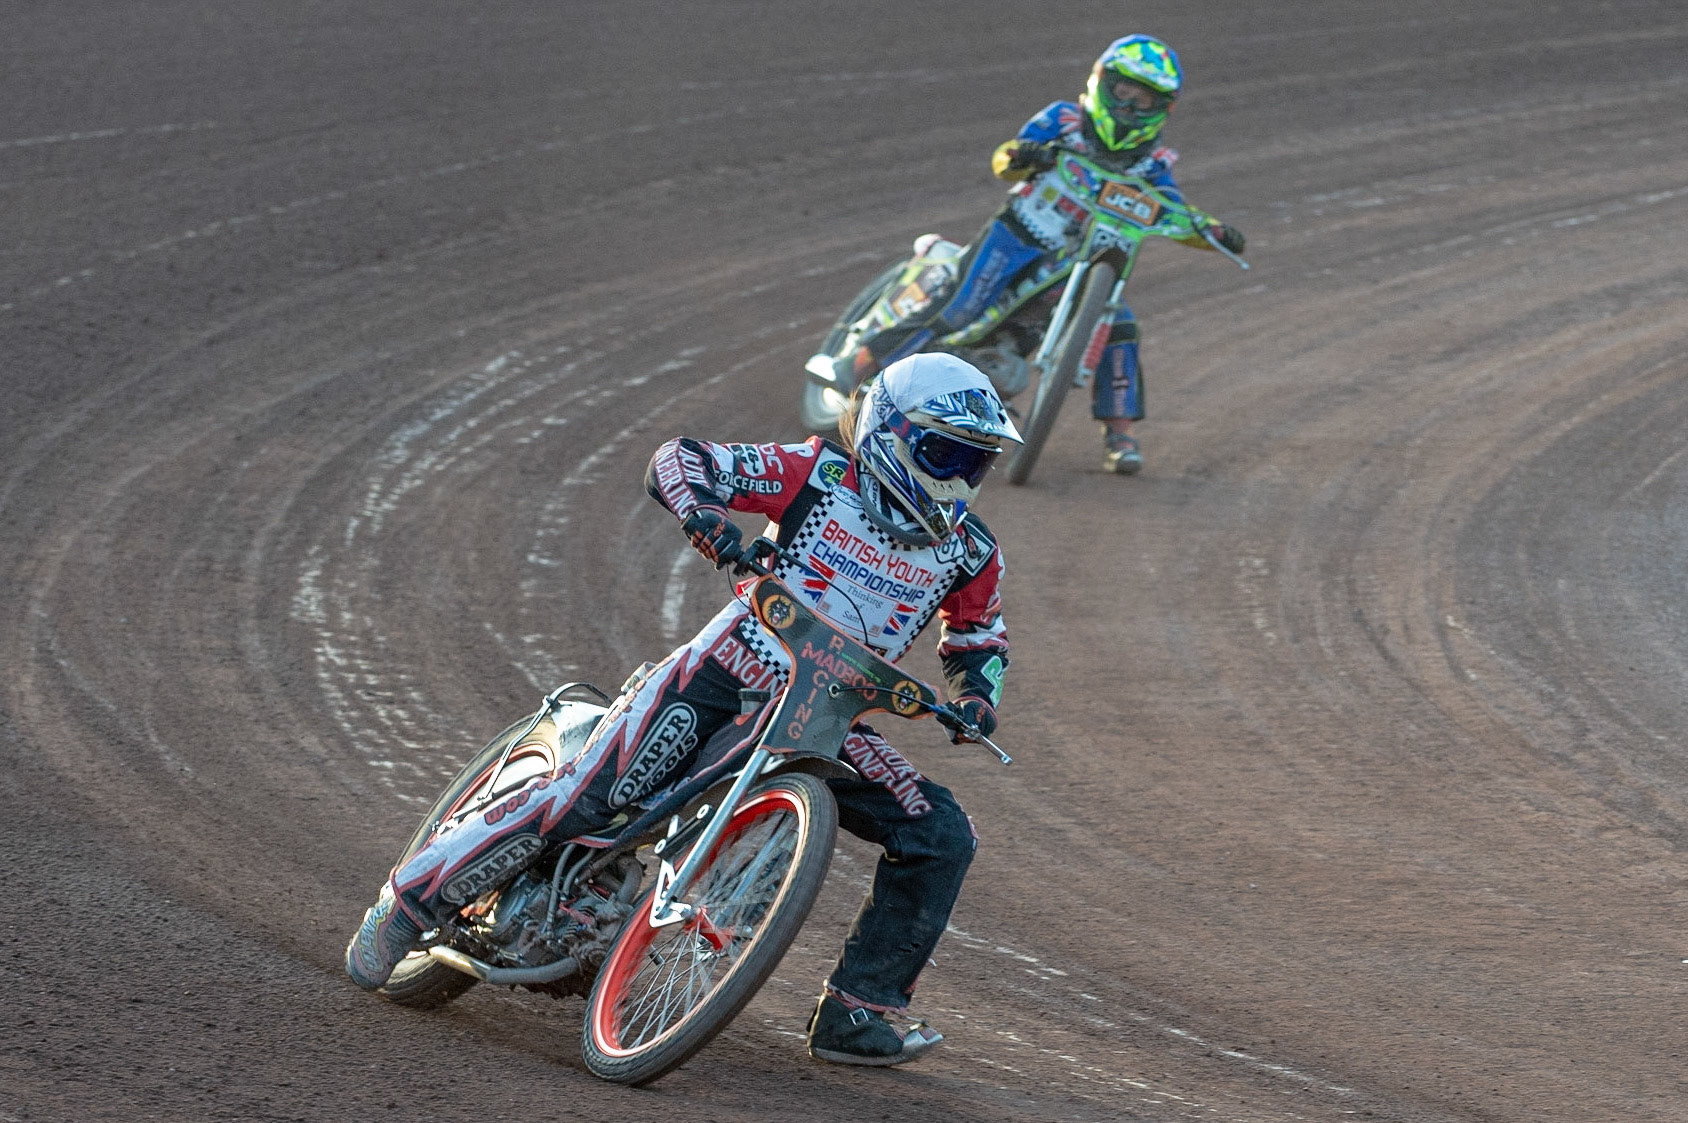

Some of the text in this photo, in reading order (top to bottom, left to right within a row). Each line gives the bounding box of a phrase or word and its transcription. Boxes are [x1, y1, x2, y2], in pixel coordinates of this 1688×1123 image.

[812, 540, 926, 603] CHAMPIONSHIP
[821, 518, 886, 571] BRITISH
[886, 553, 939, 588] YOUTH
[847, 585, 884, 610] Thinking
[618, 714, 690, 800] DRAPER
[454, 840, 537, 896] DRAPER
